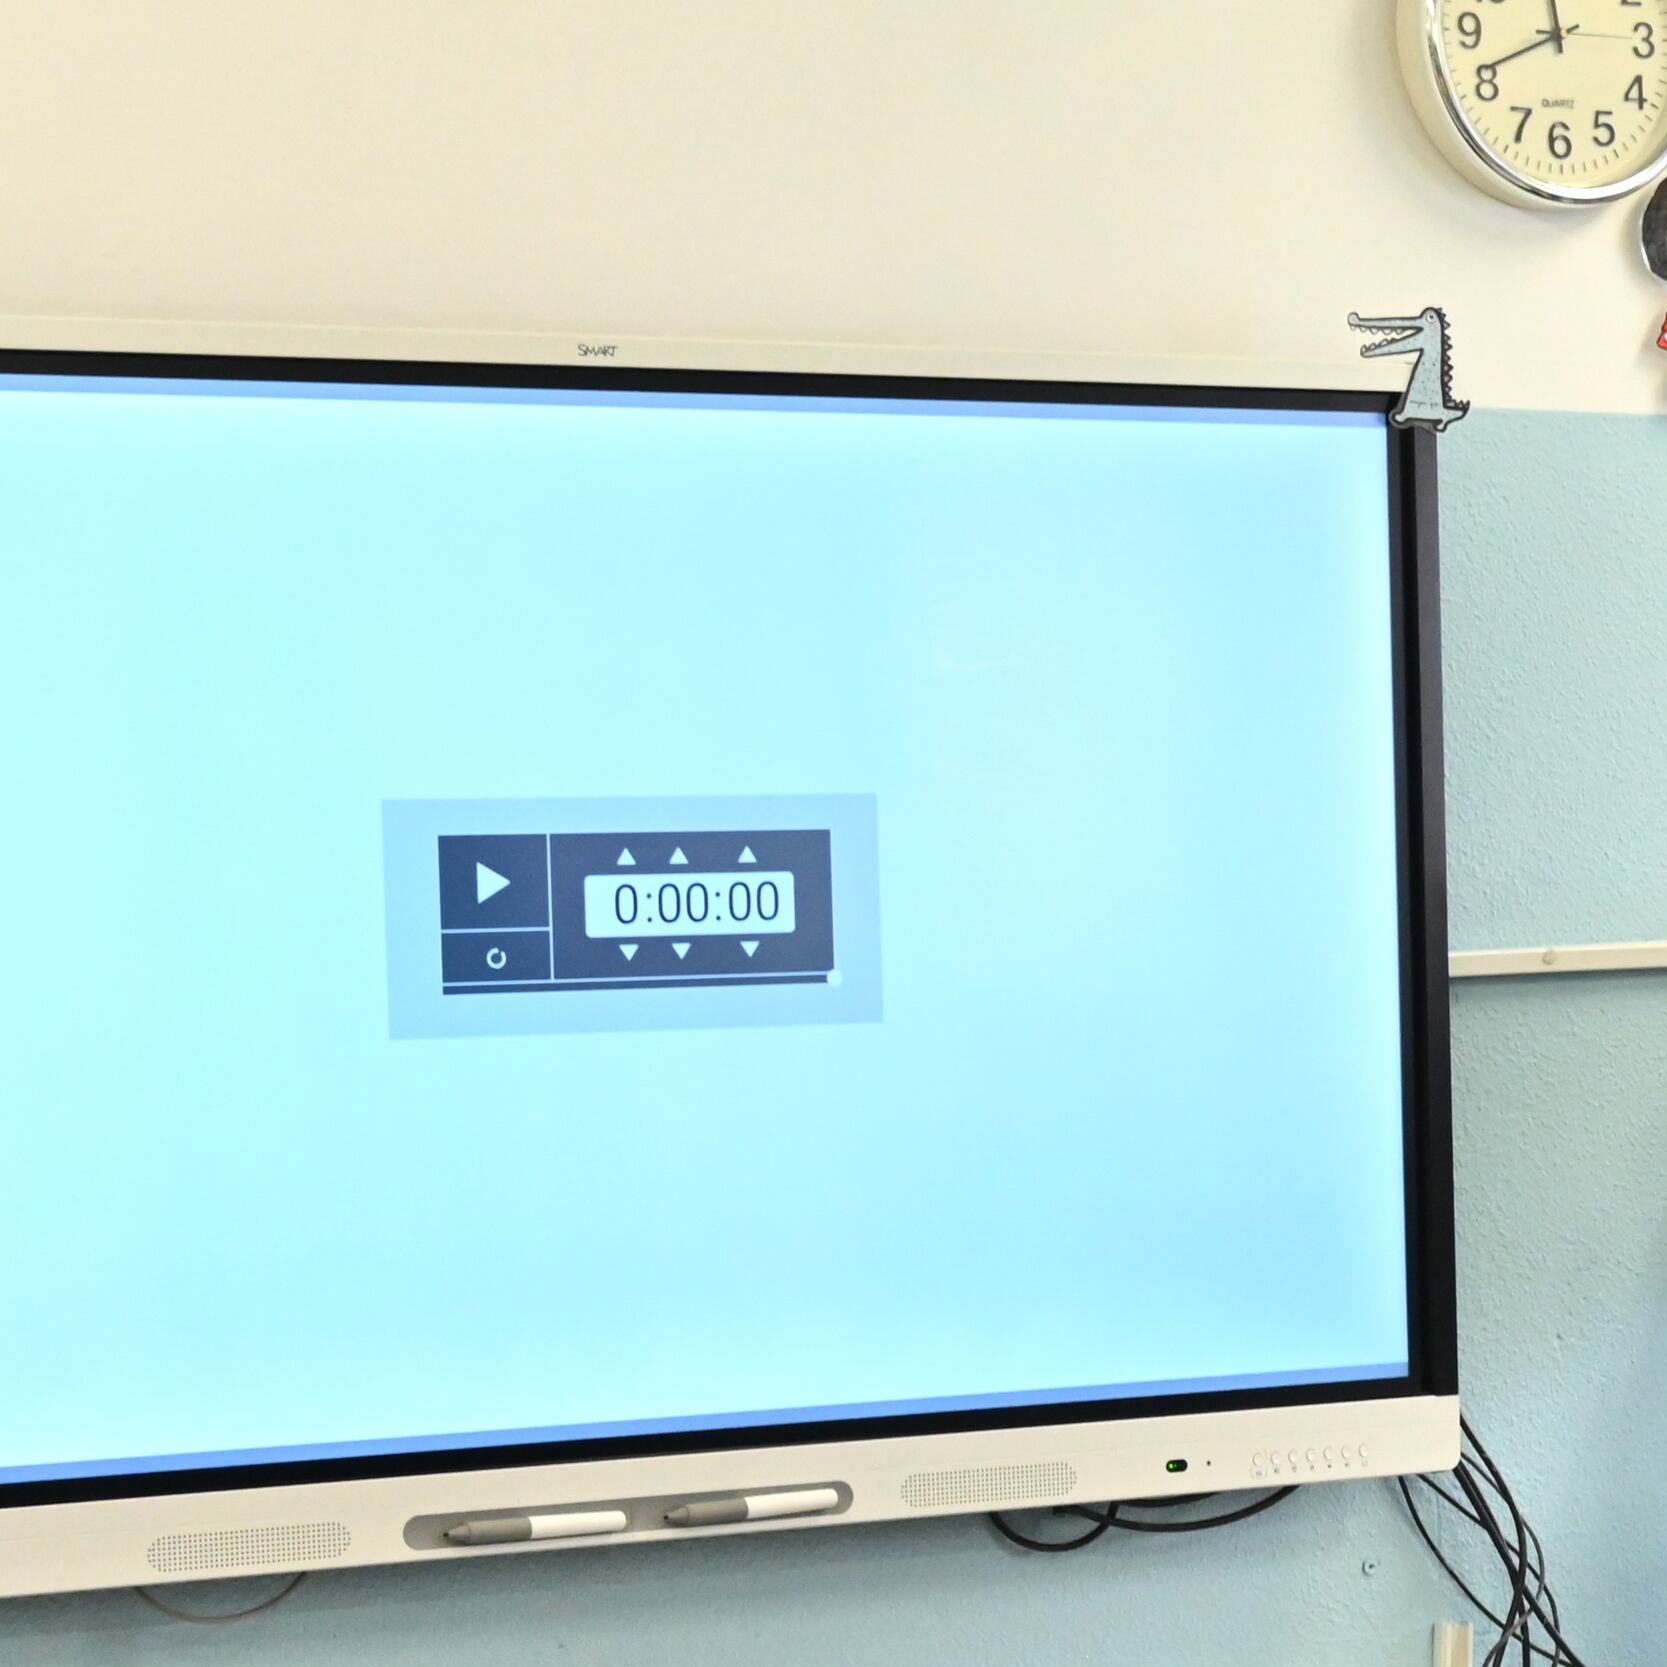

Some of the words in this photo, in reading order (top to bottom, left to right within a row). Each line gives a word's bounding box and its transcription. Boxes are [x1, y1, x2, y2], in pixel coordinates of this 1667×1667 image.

[1457, 11, 1482, 49] 9
[1632, 21, 1655, 59] 3
[1475, 64, 1499, 101] 8
[1623, 74, 1648, 111] 4
[1541, 98, 1576, 109] QUARTZ
[1510, 106, 1533, 143] 7
[1548, 121, 1572, 160] 6
[1592, 110, 1615, 147] 5
[578, 344, 618, 357] SMART
[614, 881, 780, 924] 0:00:00
